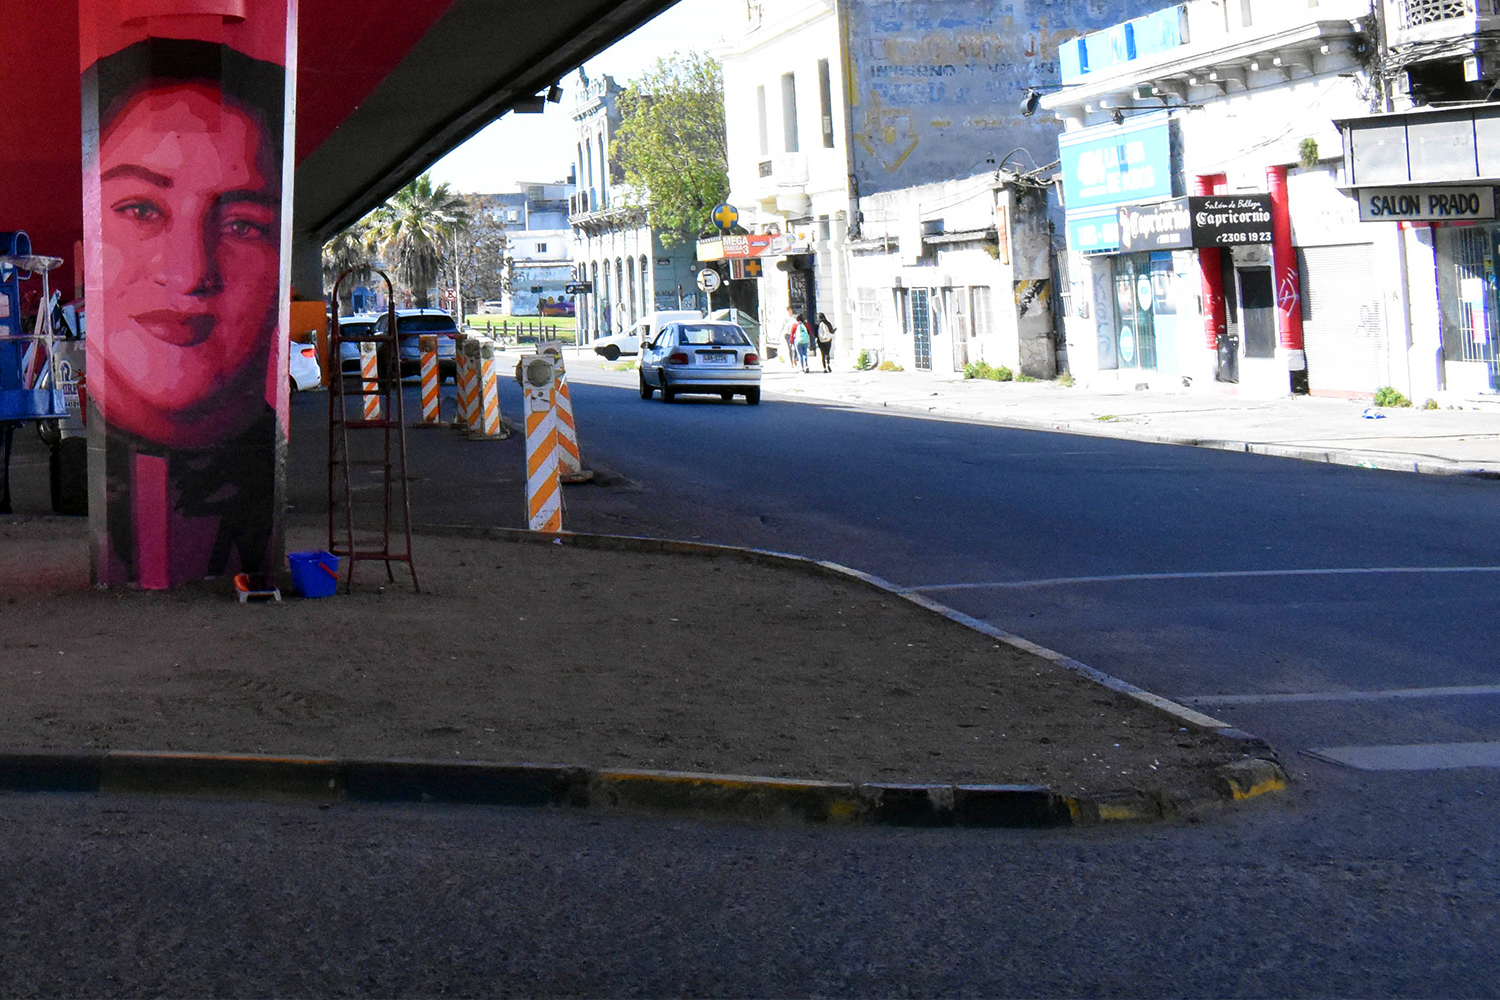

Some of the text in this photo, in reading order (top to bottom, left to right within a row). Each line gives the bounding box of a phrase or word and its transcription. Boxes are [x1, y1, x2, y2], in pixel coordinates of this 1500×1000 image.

[1370, 193, 1480, 216] SALON PRADO
[1195, 207, 1271, 227] Capricornio
[723, 236, 749, 246] MEGA
